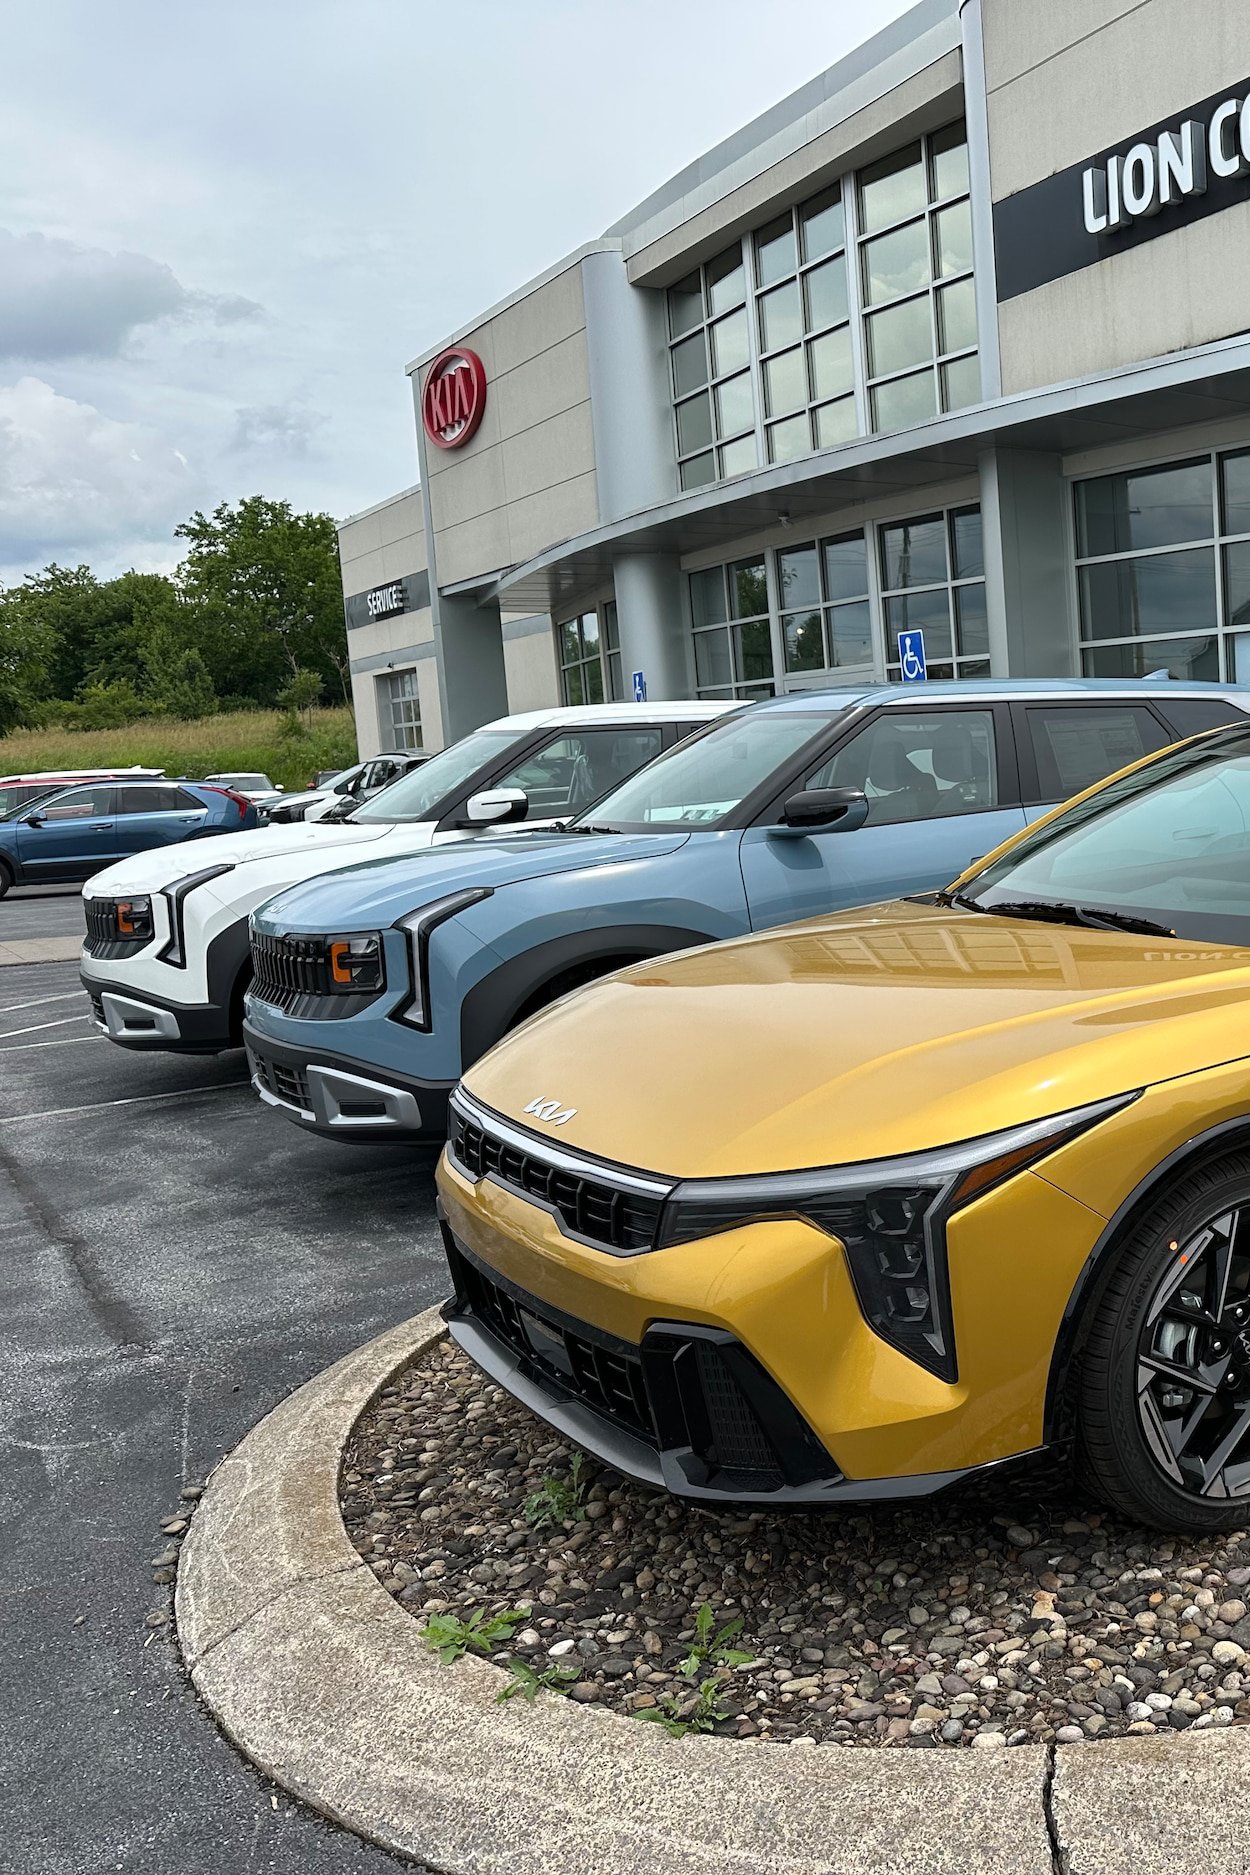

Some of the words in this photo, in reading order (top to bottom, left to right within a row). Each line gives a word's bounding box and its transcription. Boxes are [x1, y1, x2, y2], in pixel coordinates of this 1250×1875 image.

[1083, 119, 1195, 235] LION
[429, 367, 470, 432] KIA
[367, 584, 398, 616] SERVICE
[523, 1096, 578, 1126] KIA
